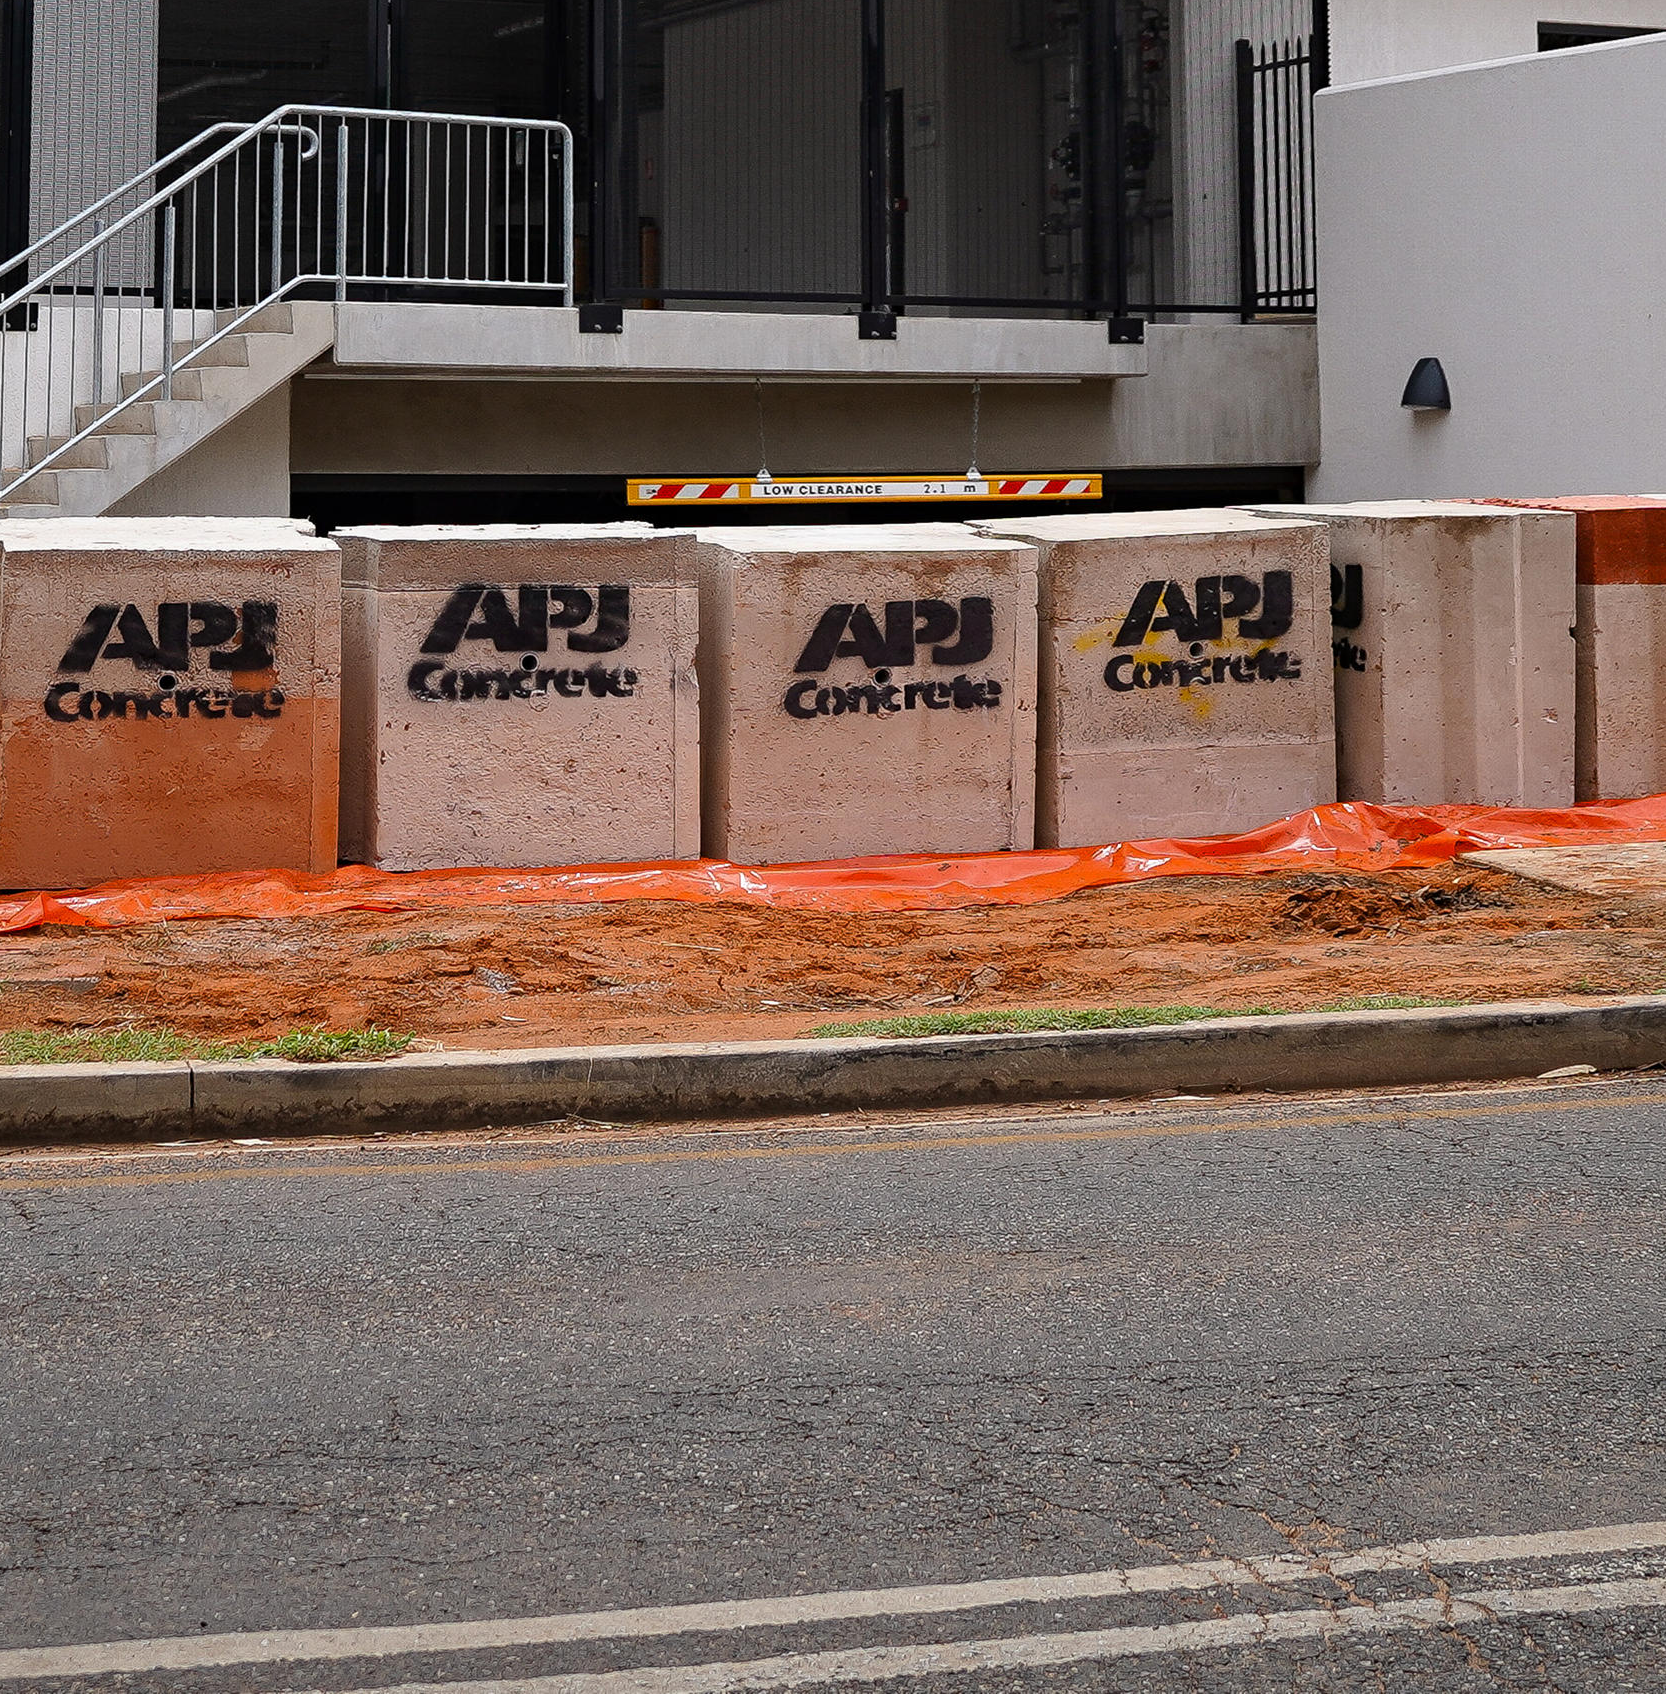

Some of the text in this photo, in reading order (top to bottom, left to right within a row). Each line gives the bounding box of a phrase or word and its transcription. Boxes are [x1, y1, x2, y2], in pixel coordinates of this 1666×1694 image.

[763, 484, 976, 495] LOW CLEARANCE 2.1 m
[419, 584, 630, 653] APJ
[1113, 570, 1293, 647] APJ
[56, 601, 276, 673] APJ
[793, 597, 994, 673] APJ
[407, 660, 638, 702] Concrete
[1103, 647, 1302, 692] Concrete
[43, 682, 285, 721] Concrete
[783, 675, 1001, 719] Concrete
